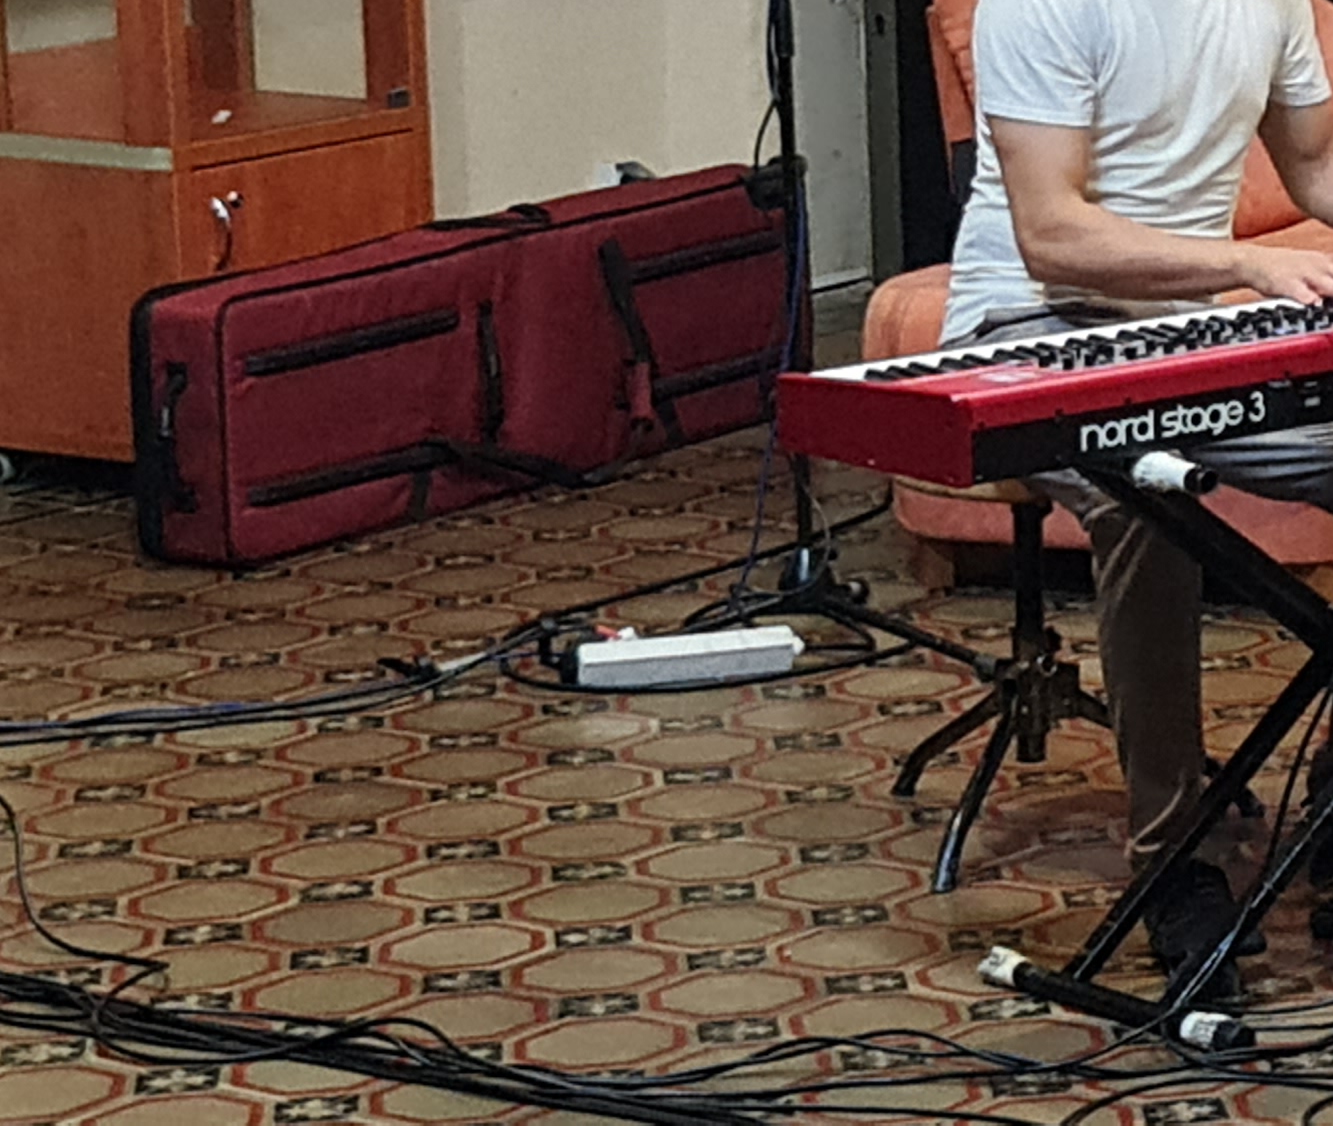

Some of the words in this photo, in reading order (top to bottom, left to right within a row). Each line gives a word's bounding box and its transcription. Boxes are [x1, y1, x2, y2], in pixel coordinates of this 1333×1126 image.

[1080, 409, 1155, 452] nord
[1160, 404, 1244, 438] stage
[1248, 391, 1266, 422] 3
